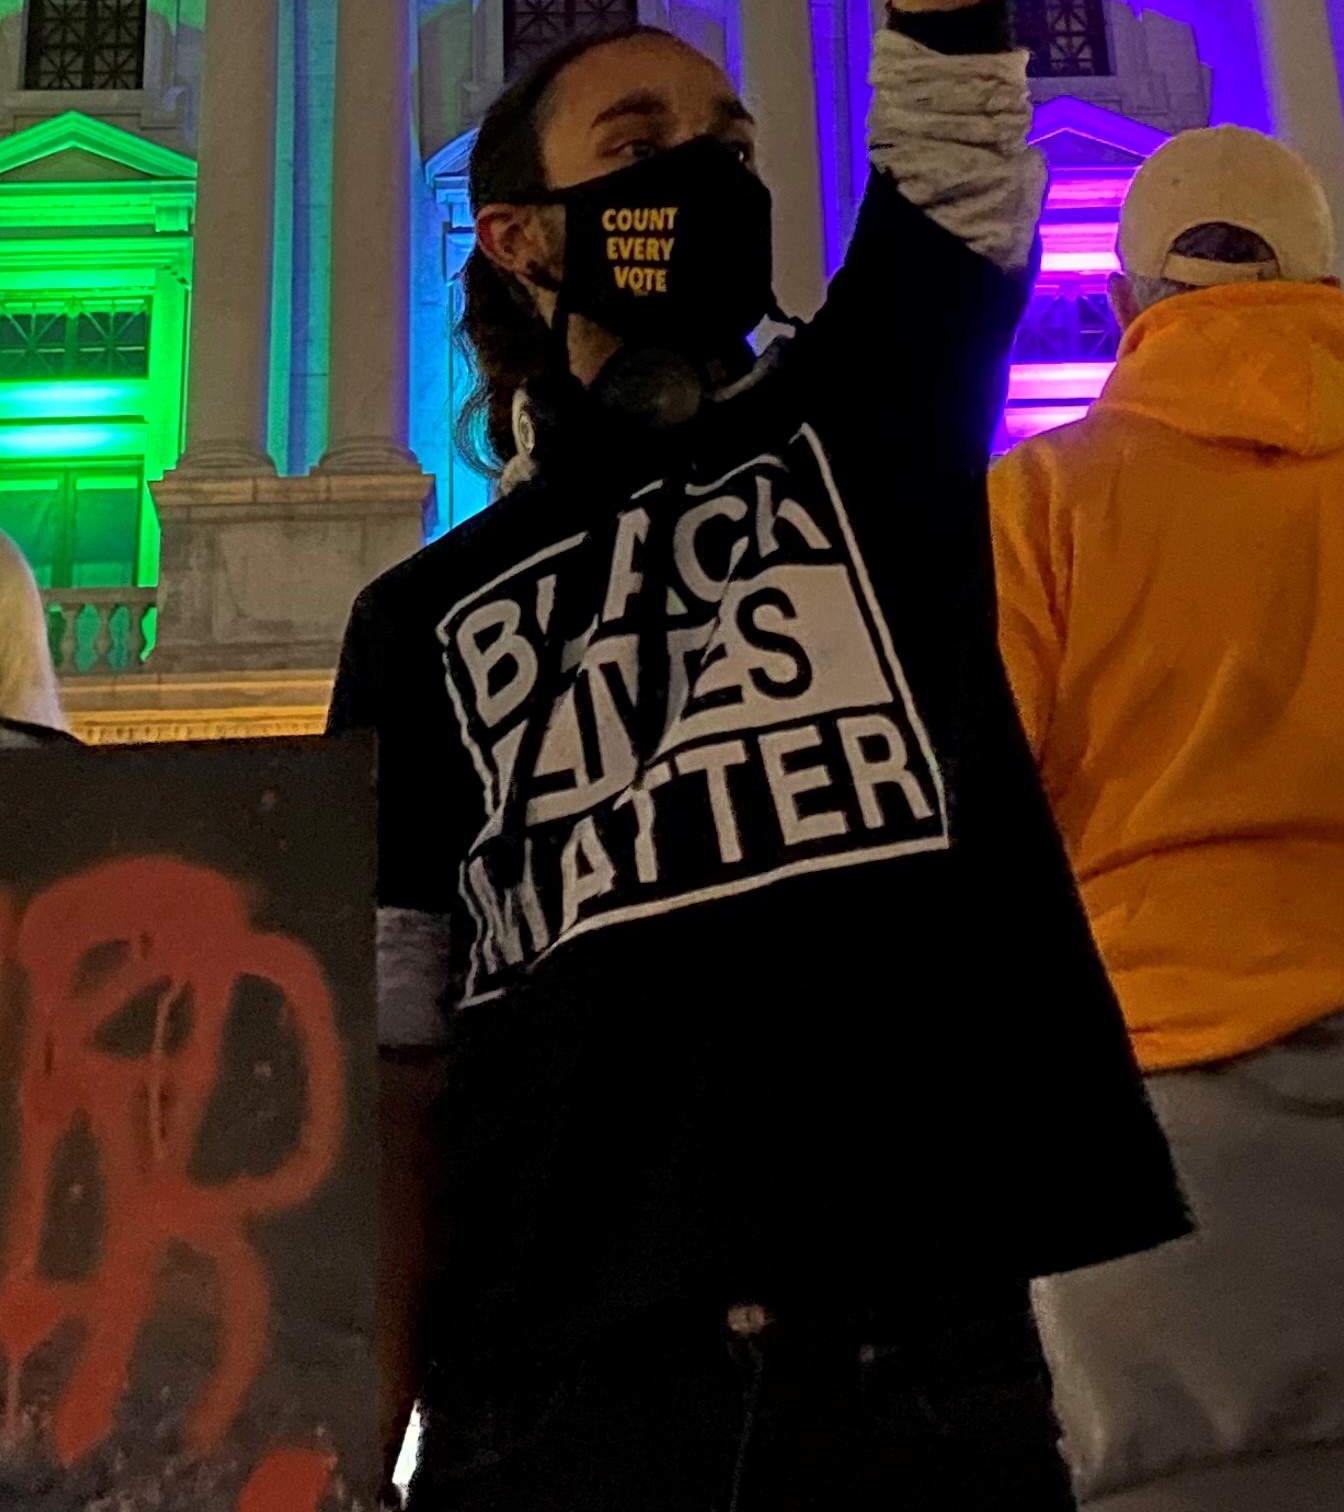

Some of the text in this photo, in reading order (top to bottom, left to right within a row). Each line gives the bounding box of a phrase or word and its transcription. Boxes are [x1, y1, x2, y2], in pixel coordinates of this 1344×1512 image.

[602, 207, 678, 231] COUNT
[607, 237, 674, 261] EVERY
[614, 266, 667, 292] VOTE
[468, 715, 935, 975] MATTER
